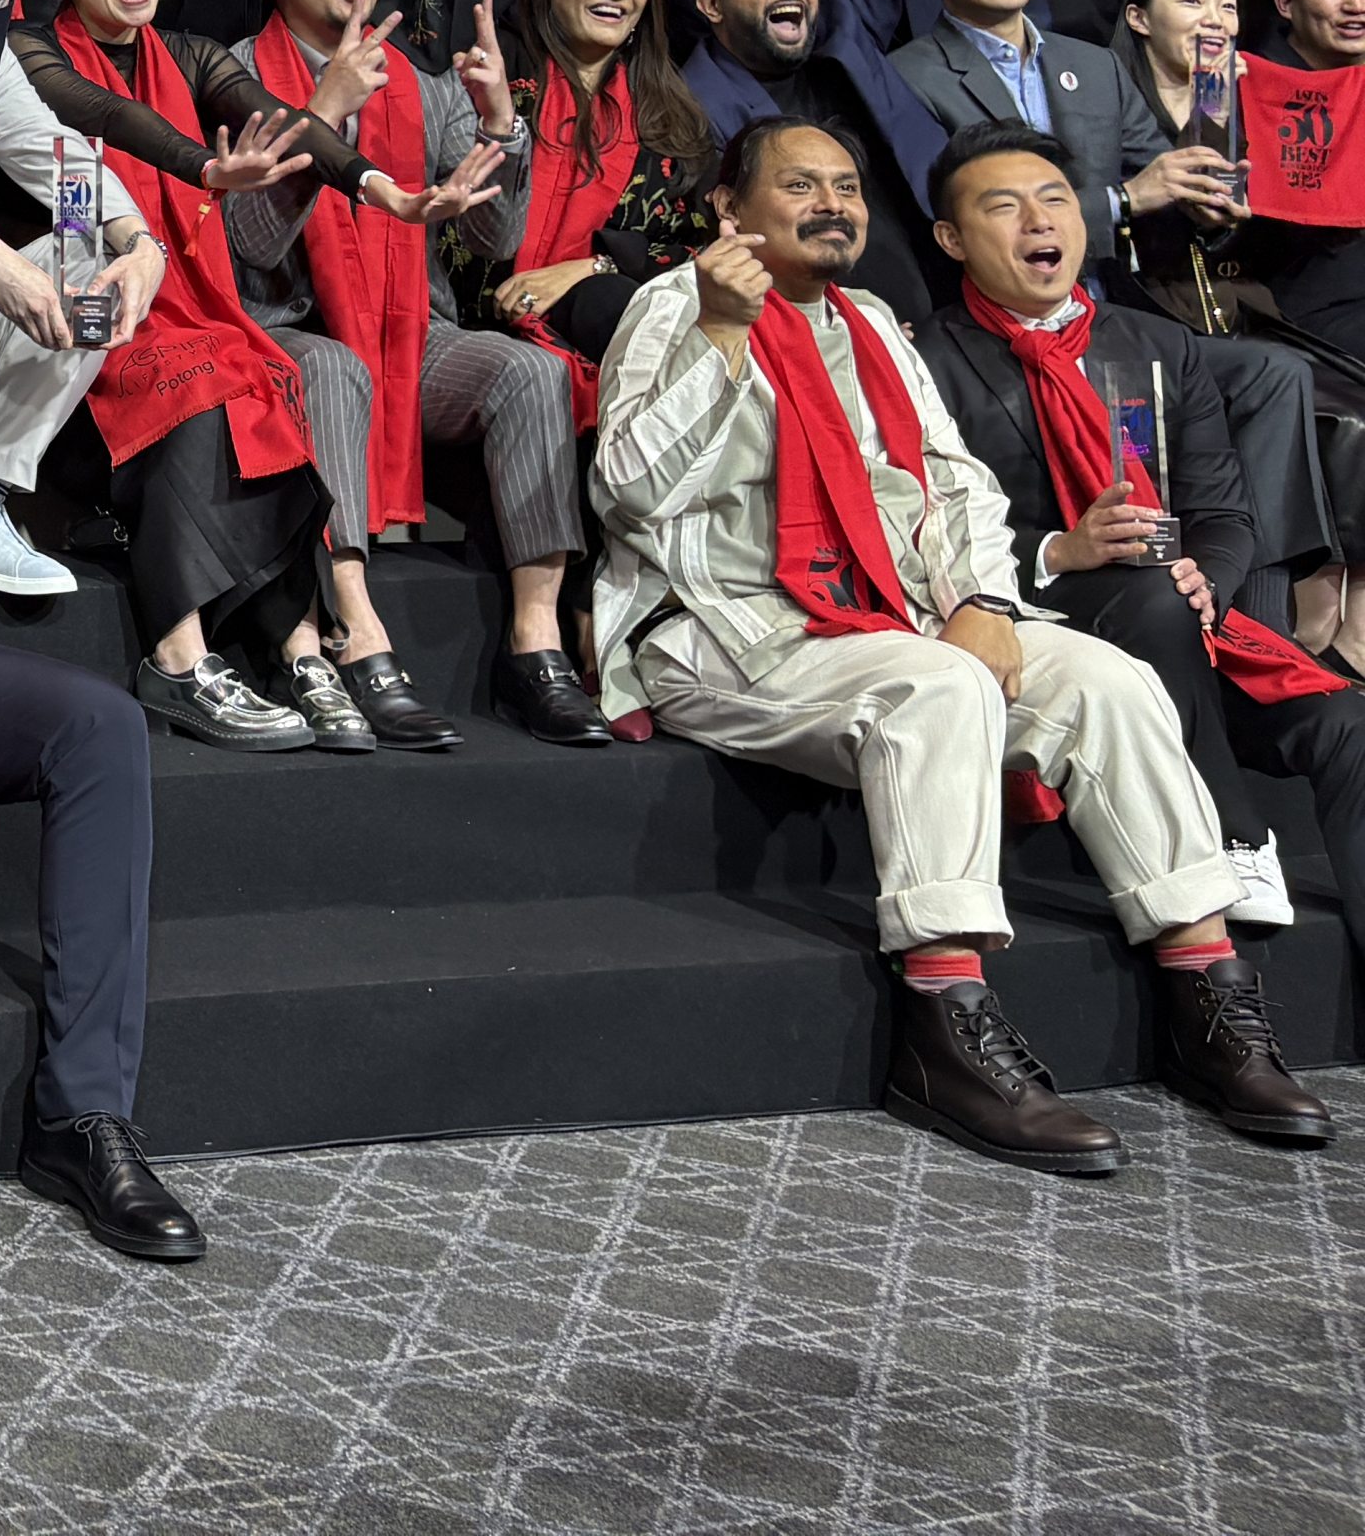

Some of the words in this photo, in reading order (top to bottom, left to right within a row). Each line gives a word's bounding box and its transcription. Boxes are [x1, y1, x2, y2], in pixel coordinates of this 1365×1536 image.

[1278, 101, 1334, 149] 50
[1280, 144, 1331, 163] BEST
[155, 360, 215, 397] Potong
